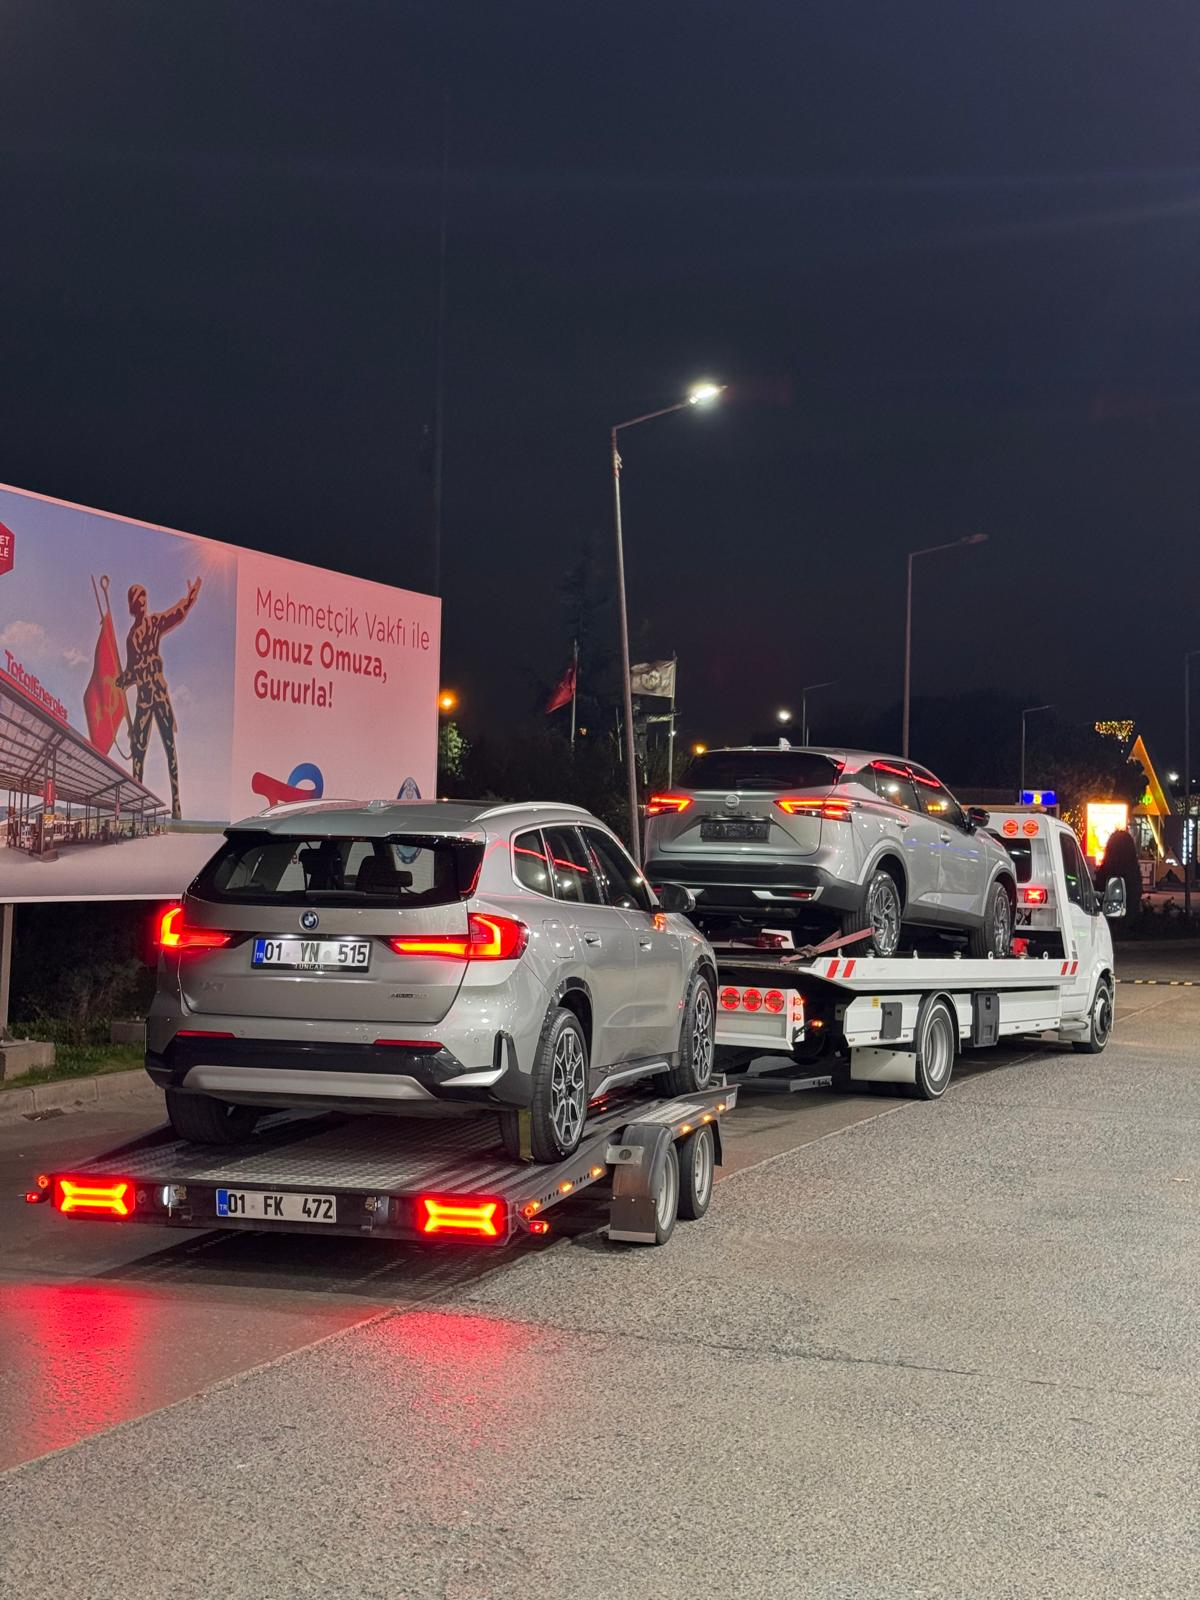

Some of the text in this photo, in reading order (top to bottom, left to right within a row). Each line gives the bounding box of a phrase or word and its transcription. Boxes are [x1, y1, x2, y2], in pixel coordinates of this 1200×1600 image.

[256, 587, 359, 638] Mehmetçik
[412, 622, 430, 651] ile
[255, 627, 387, 684] Omuz Omuza,
[4, 649, 68, 721] TotalEnergies
[254, 669, 333, 708] Gururla!
[264, 942, 283, 961] 01
[300, 942, 321, 962] YN
[338, 944, 368, 964] 515
[228, 1193, 246, 1214] 01
[263, 1195, 284, 1216] FK
[302, 1198, 333, 1219] 472
